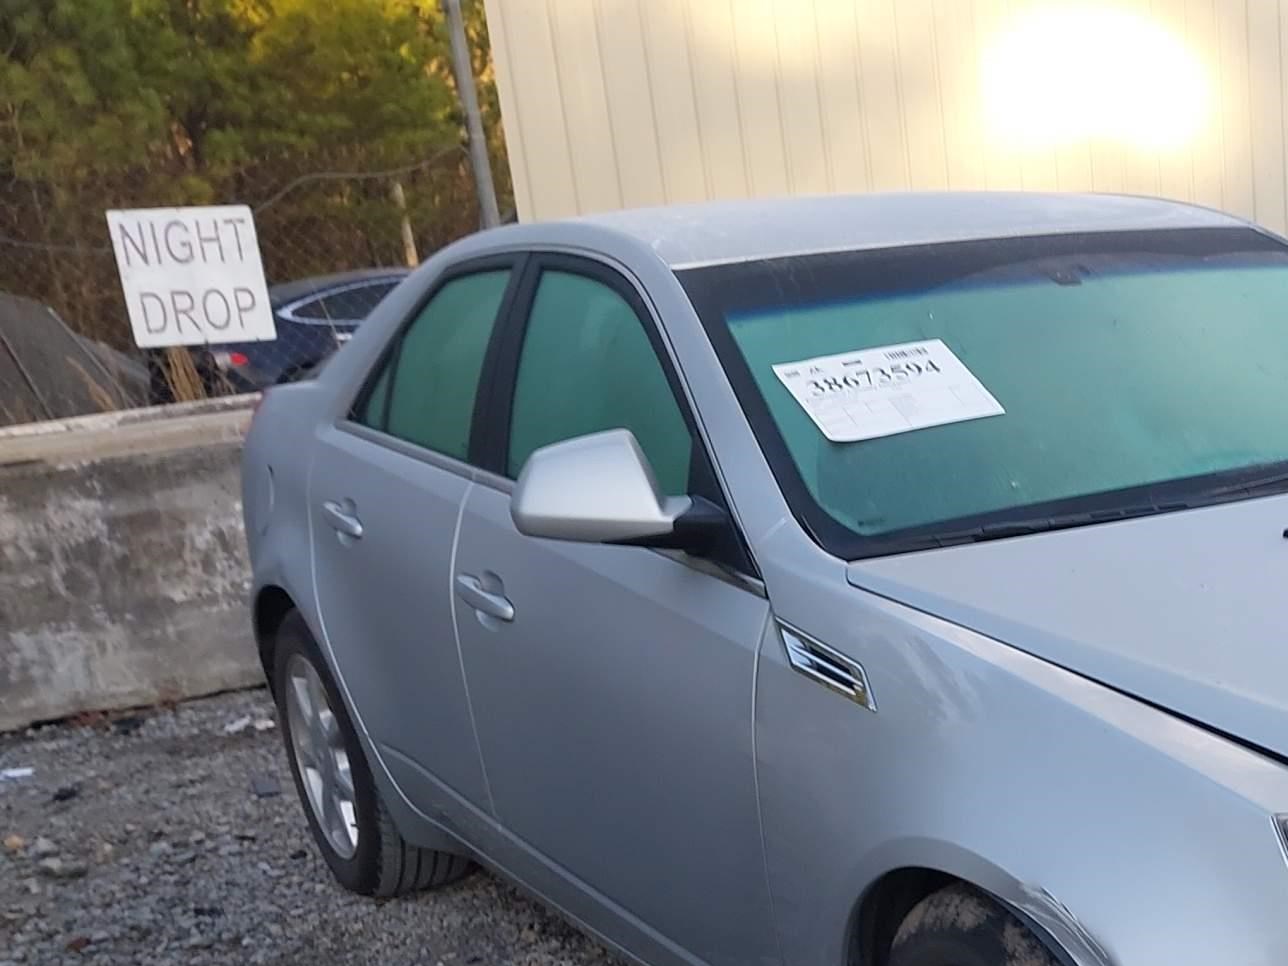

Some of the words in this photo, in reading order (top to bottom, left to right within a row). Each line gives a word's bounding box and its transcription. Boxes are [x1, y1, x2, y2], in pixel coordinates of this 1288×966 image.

[118, 218, 246, 267] NIGHT
[139, 287, 257, 334] DROP
[806, 358, 942, 398] 38673594
